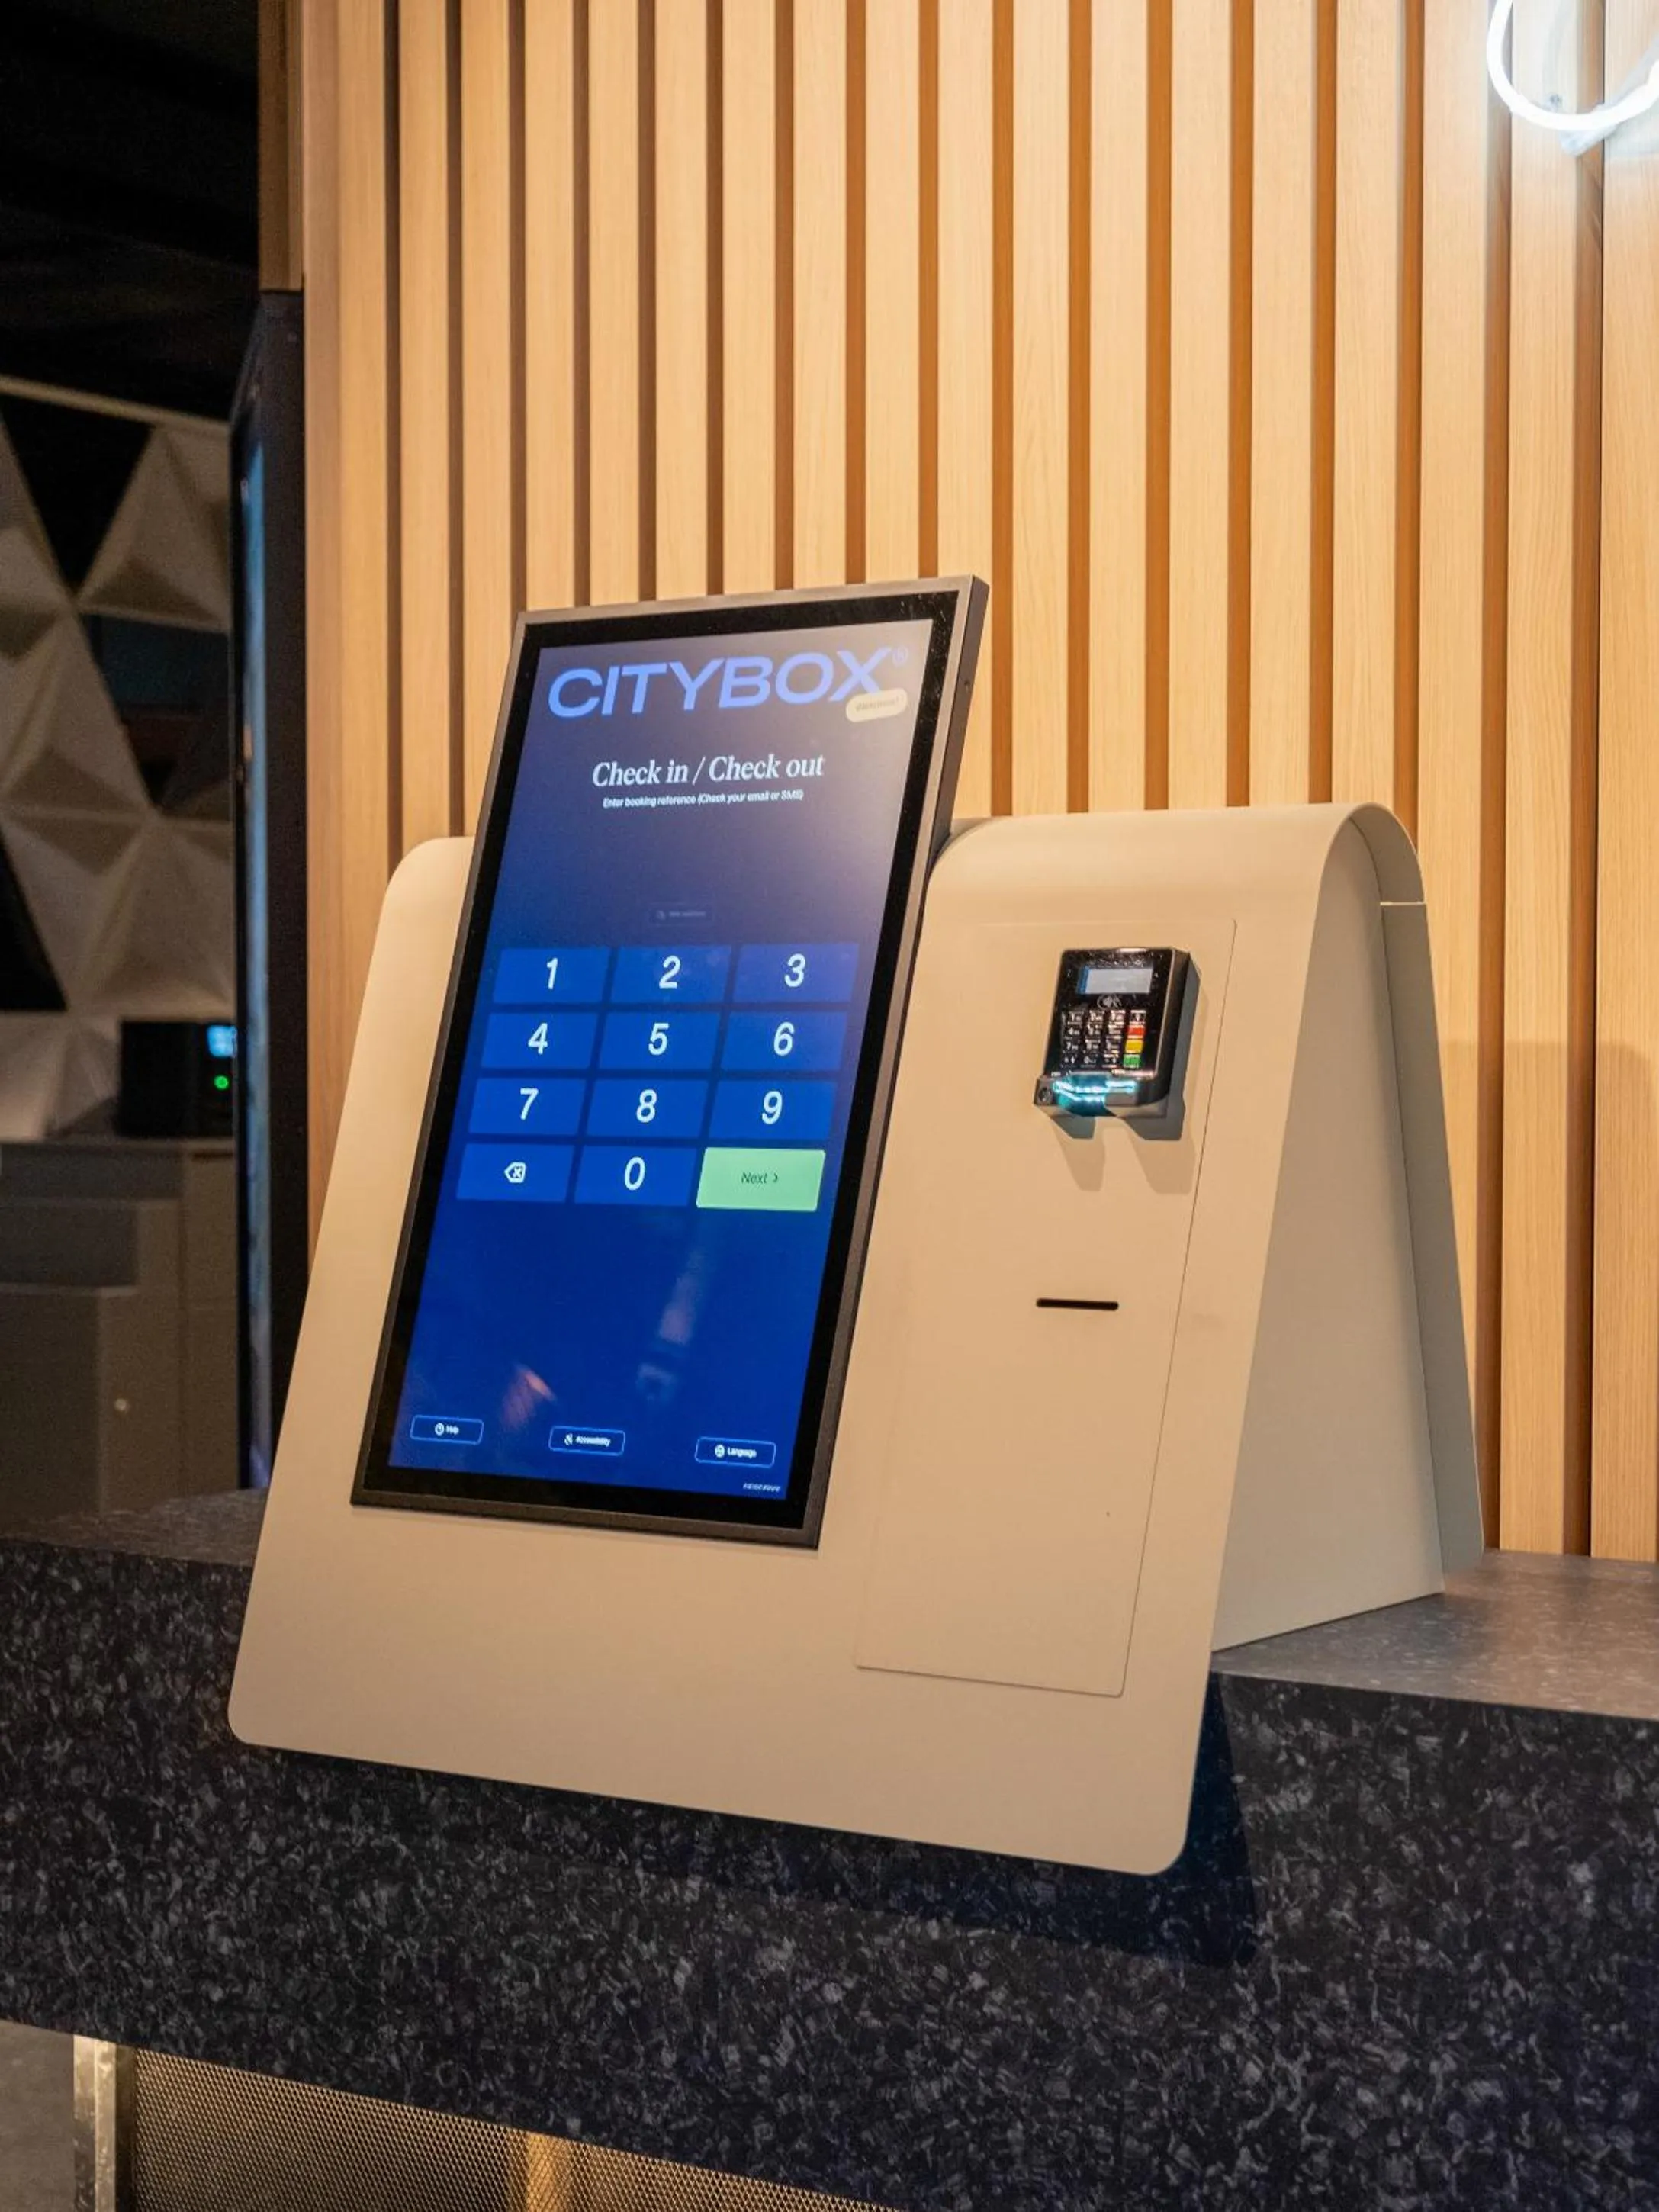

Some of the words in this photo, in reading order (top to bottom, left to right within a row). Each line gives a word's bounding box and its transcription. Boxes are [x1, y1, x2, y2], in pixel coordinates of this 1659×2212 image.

[548, 646, 892, 719] CITYBOX
[592, 759, 662, 787] Check
[666, 758, 688, 784] in
[692, 756, 706, 786] /
[709, 753, 781, 782] Check
[786, 754, 825, 779] out
[603, 797, 625, 809] Enter
[625, 796, 657, 809] booking
[657, 795, 697, 806] reference
[697, 793, 726, 806] (Check
[726, 793, 747, 805] your
[747, 790, 770, 802] email
[770, 791, 780, 801] or
[780, 789, 804, 801] SMS)
[546, 957, 558, 989] 1
[658, 955, 681, 989] 2
[784, 953, 806, 987] 3
[527, 1022, 548, 1055] 4
[648, 1022, 670, 1056] 5
[773, 1021, 795, 1056] 6
[519, 1088, 539, 1120] 7
[636, 1088, 657, 1123] 8
[761, 1090, 783, 1125] 9
[624, 1156, 645, 1191] 0
[741, 1172, 768, 1185] Next
[727, 1447, 757, 1458] Language
